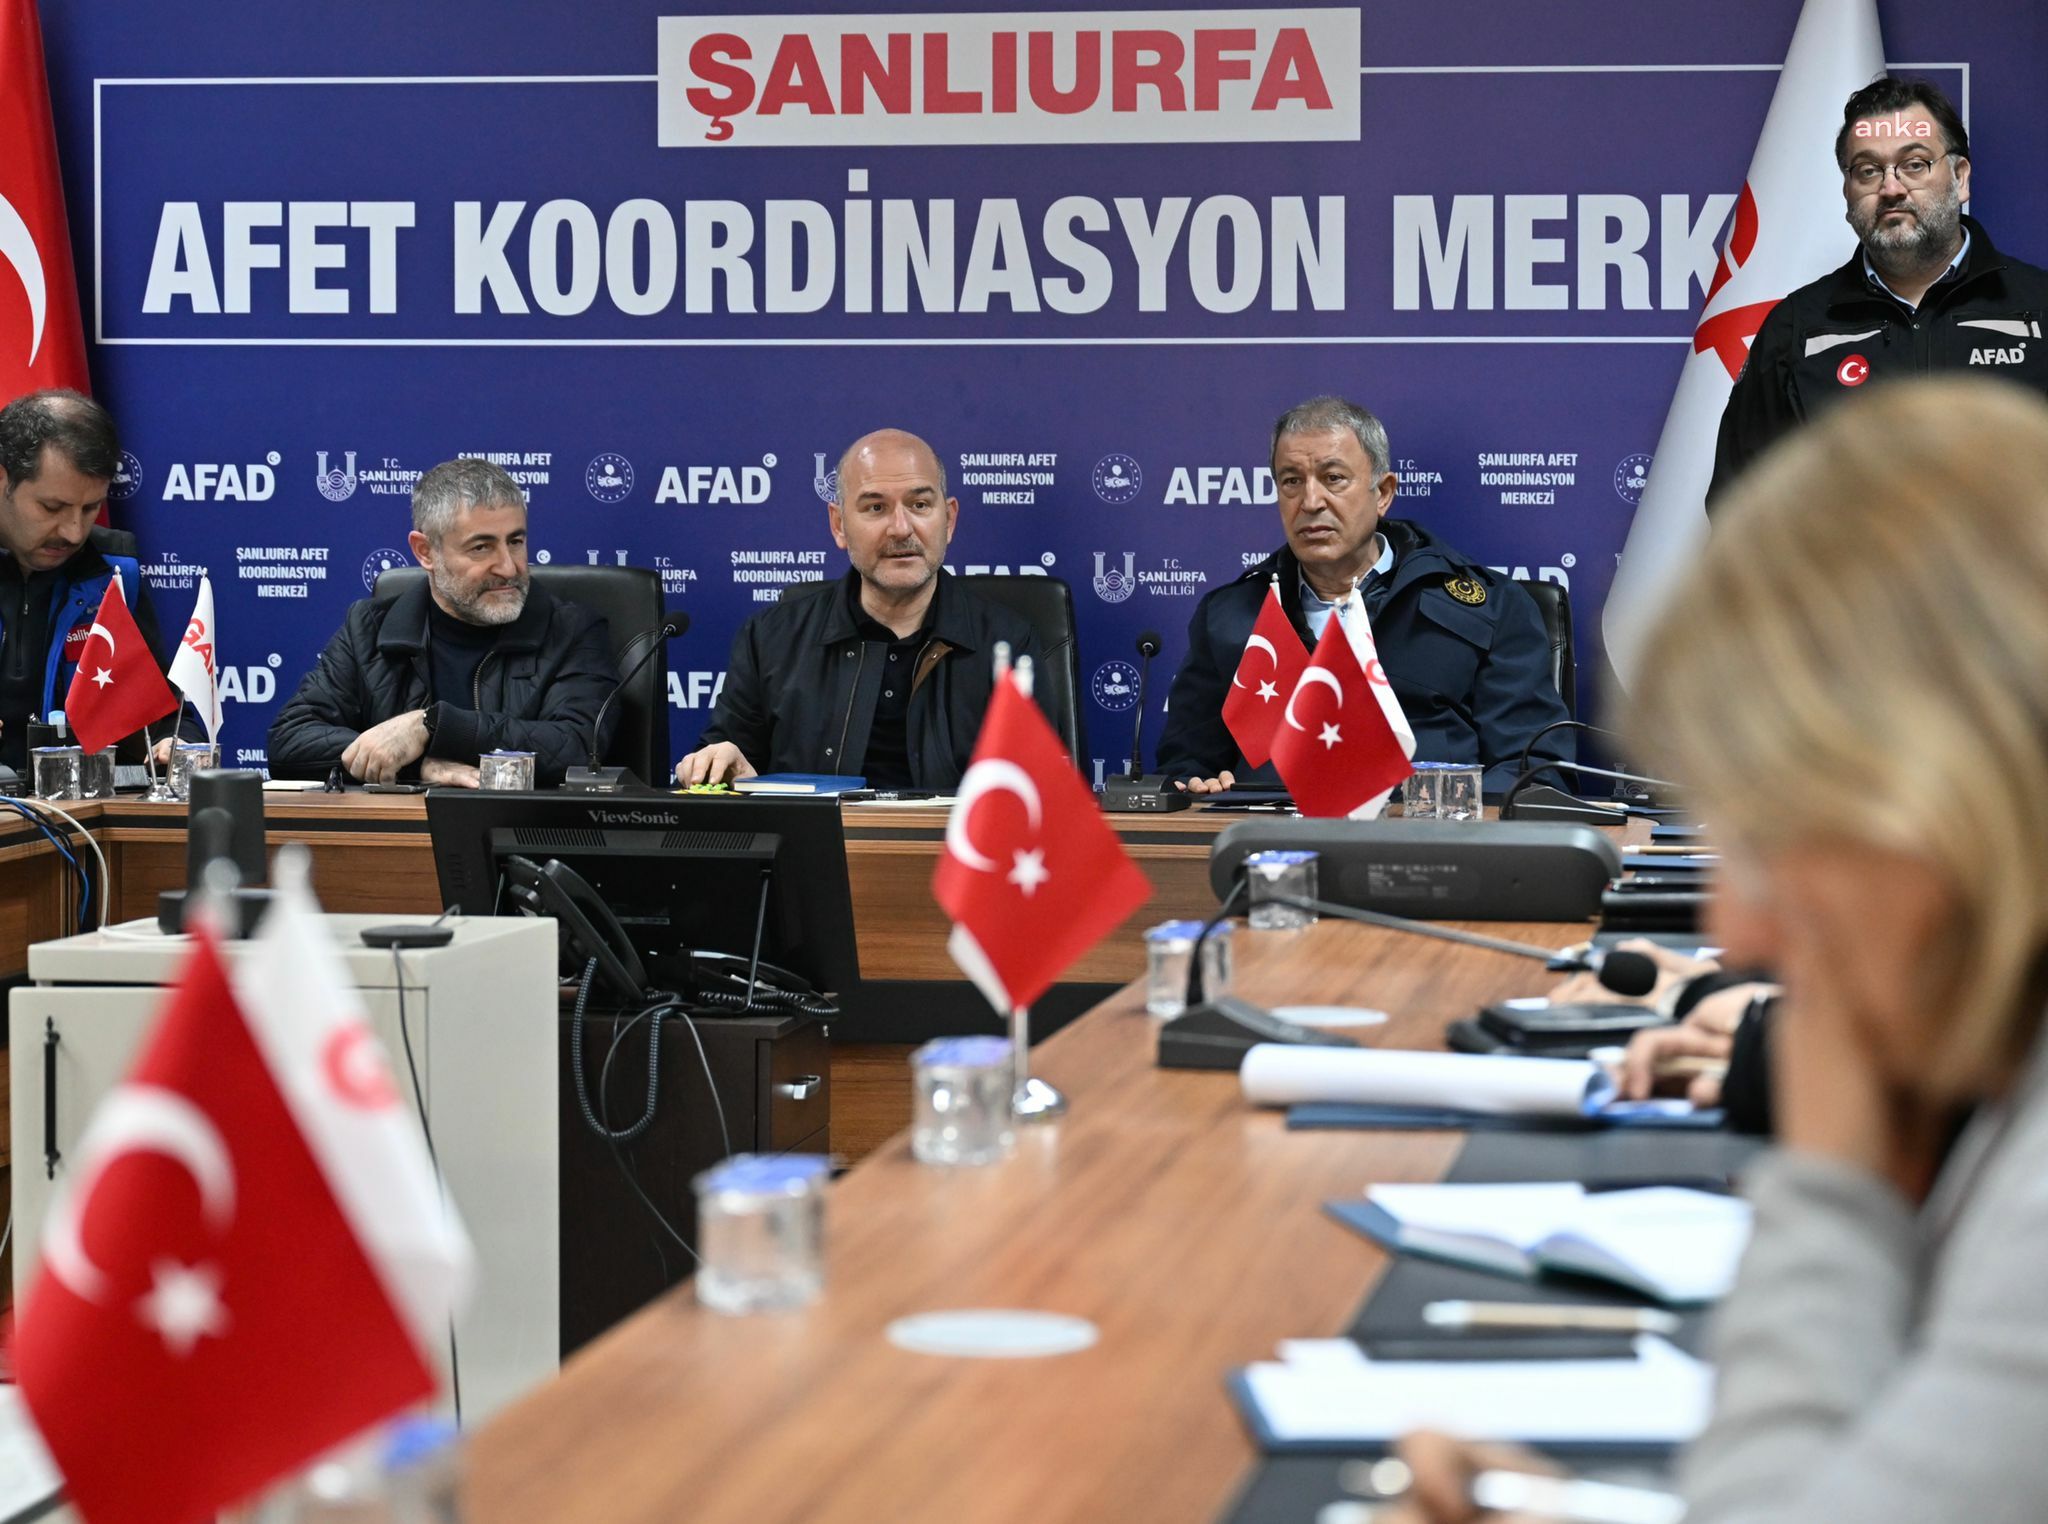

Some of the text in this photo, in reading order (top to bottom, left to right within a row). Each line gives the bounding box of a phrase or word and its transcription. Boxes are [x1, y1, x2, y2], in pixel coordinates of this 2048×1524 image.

[687, 28, 1333, 141] ŞANLIURFA
[142, 169, 1738, 316] AFET KOORDİNASYON MERK
[1969, 347, 2025, 365] AFAD
[383, 458, 400, 468] T.C.
[523, 453, 551, 465] AFET
[961, 454, 1057, 468] ŞANLIURFA AFET
[1398, 460, 1417, 469] T.C.
[1479, 453, 1578, 468] ŞANLIURFA AFET
[163, 464, 275, 501] AFAD
[359, 470, 423, 484] ŞANLIURFA
[963, 470, 1054, 485] KOORDİNASYON
[1394, 472, 1443, 483] LIURFA
[1481, 470, 1575, 485] KOORDİNASYON
[655, 467, 770, 503] AFAD
[1163, 467, 1278, 505] AFAD
[1394, 483, 1431, 497] LİLİĞİ
[983, 489, 1034, 504] MERKEZİ
[1501, 489, 1554, 504] MERKEZİ
[162, 553, 180, 563] T.C.
[237, 548, 329, 562] ŞANLIURFA AFET
[654, 557, 673, 567] T.C.
[731, 551, 826, 566] ŞANLIURFA AFET
[1163, 559, 1181, 569] T.C.
[140, 565, 202, 578] ŞANLIURFA
[239, 564, 326, 579] KOORDİNASYON
[656, 569, 697, 580] IURFA
[733, 567, 824, 583] KOORDİNASYON
[1138, 572, 1206, 584] ŞANLIURFA
[150, 576, 192, 588] VALİLİĞİ
[1150, 583, 1194, 595] VALİLİĞİ
[258, 583, 307, 597] MERKEZİ
[216, 666, 276, 703] AD
[668, 672, 727, 709] AF
[588, 809, 680, 826] ViewSonic
